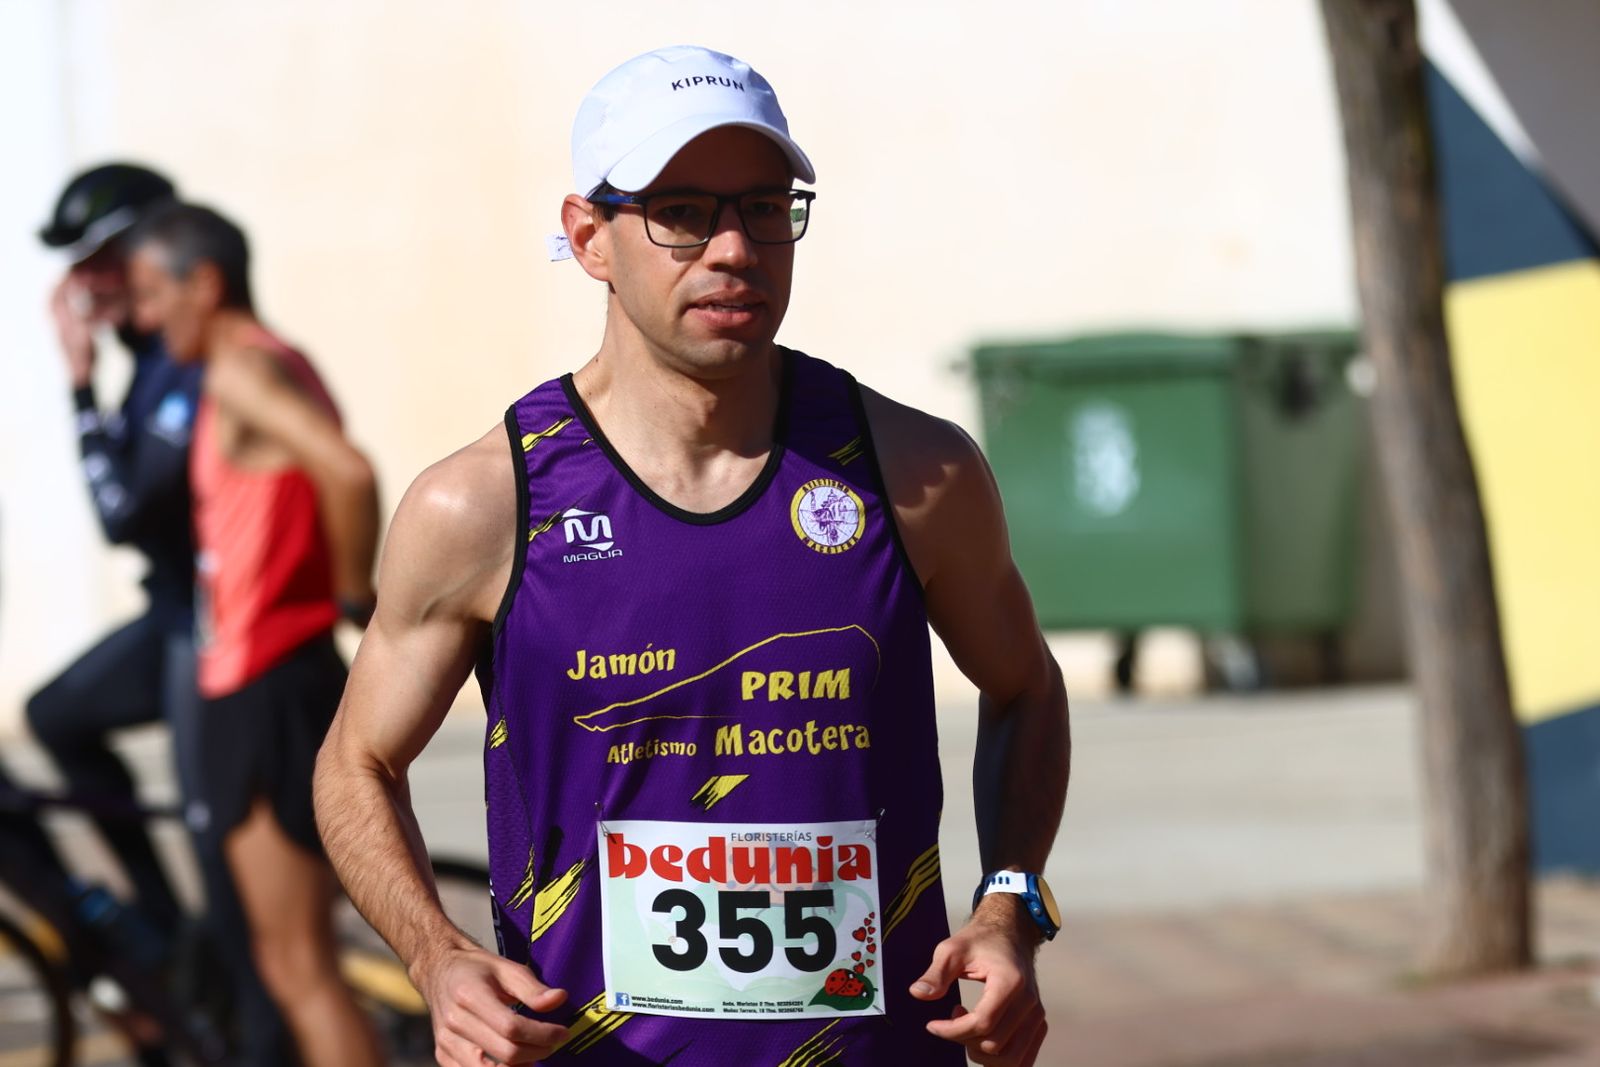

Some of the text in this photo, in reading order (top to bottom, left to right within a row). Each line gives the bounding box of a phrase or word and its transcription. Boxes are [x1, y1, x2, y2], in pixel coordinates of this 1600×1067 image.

[671, 75, 745, 92] KIPRUN
[563, 549, 623, 563] MAGLIA
[566, 643, 676, 680] Jamón
[741, 668, 850, 701] PRIM
[715, 720, 870, 756] Macotera
[607, 739, 697, 765] Atletismo
[731, 830, 812, 842] FLORISTERÍAS
[607, 833, 872, 884] bedunia
[652, 888, 837, 973] 355
[631, 995, 684, 1005] www.bedunia.com
[632, 1002, 715, 1013] www.floristeriasbedunia.com
